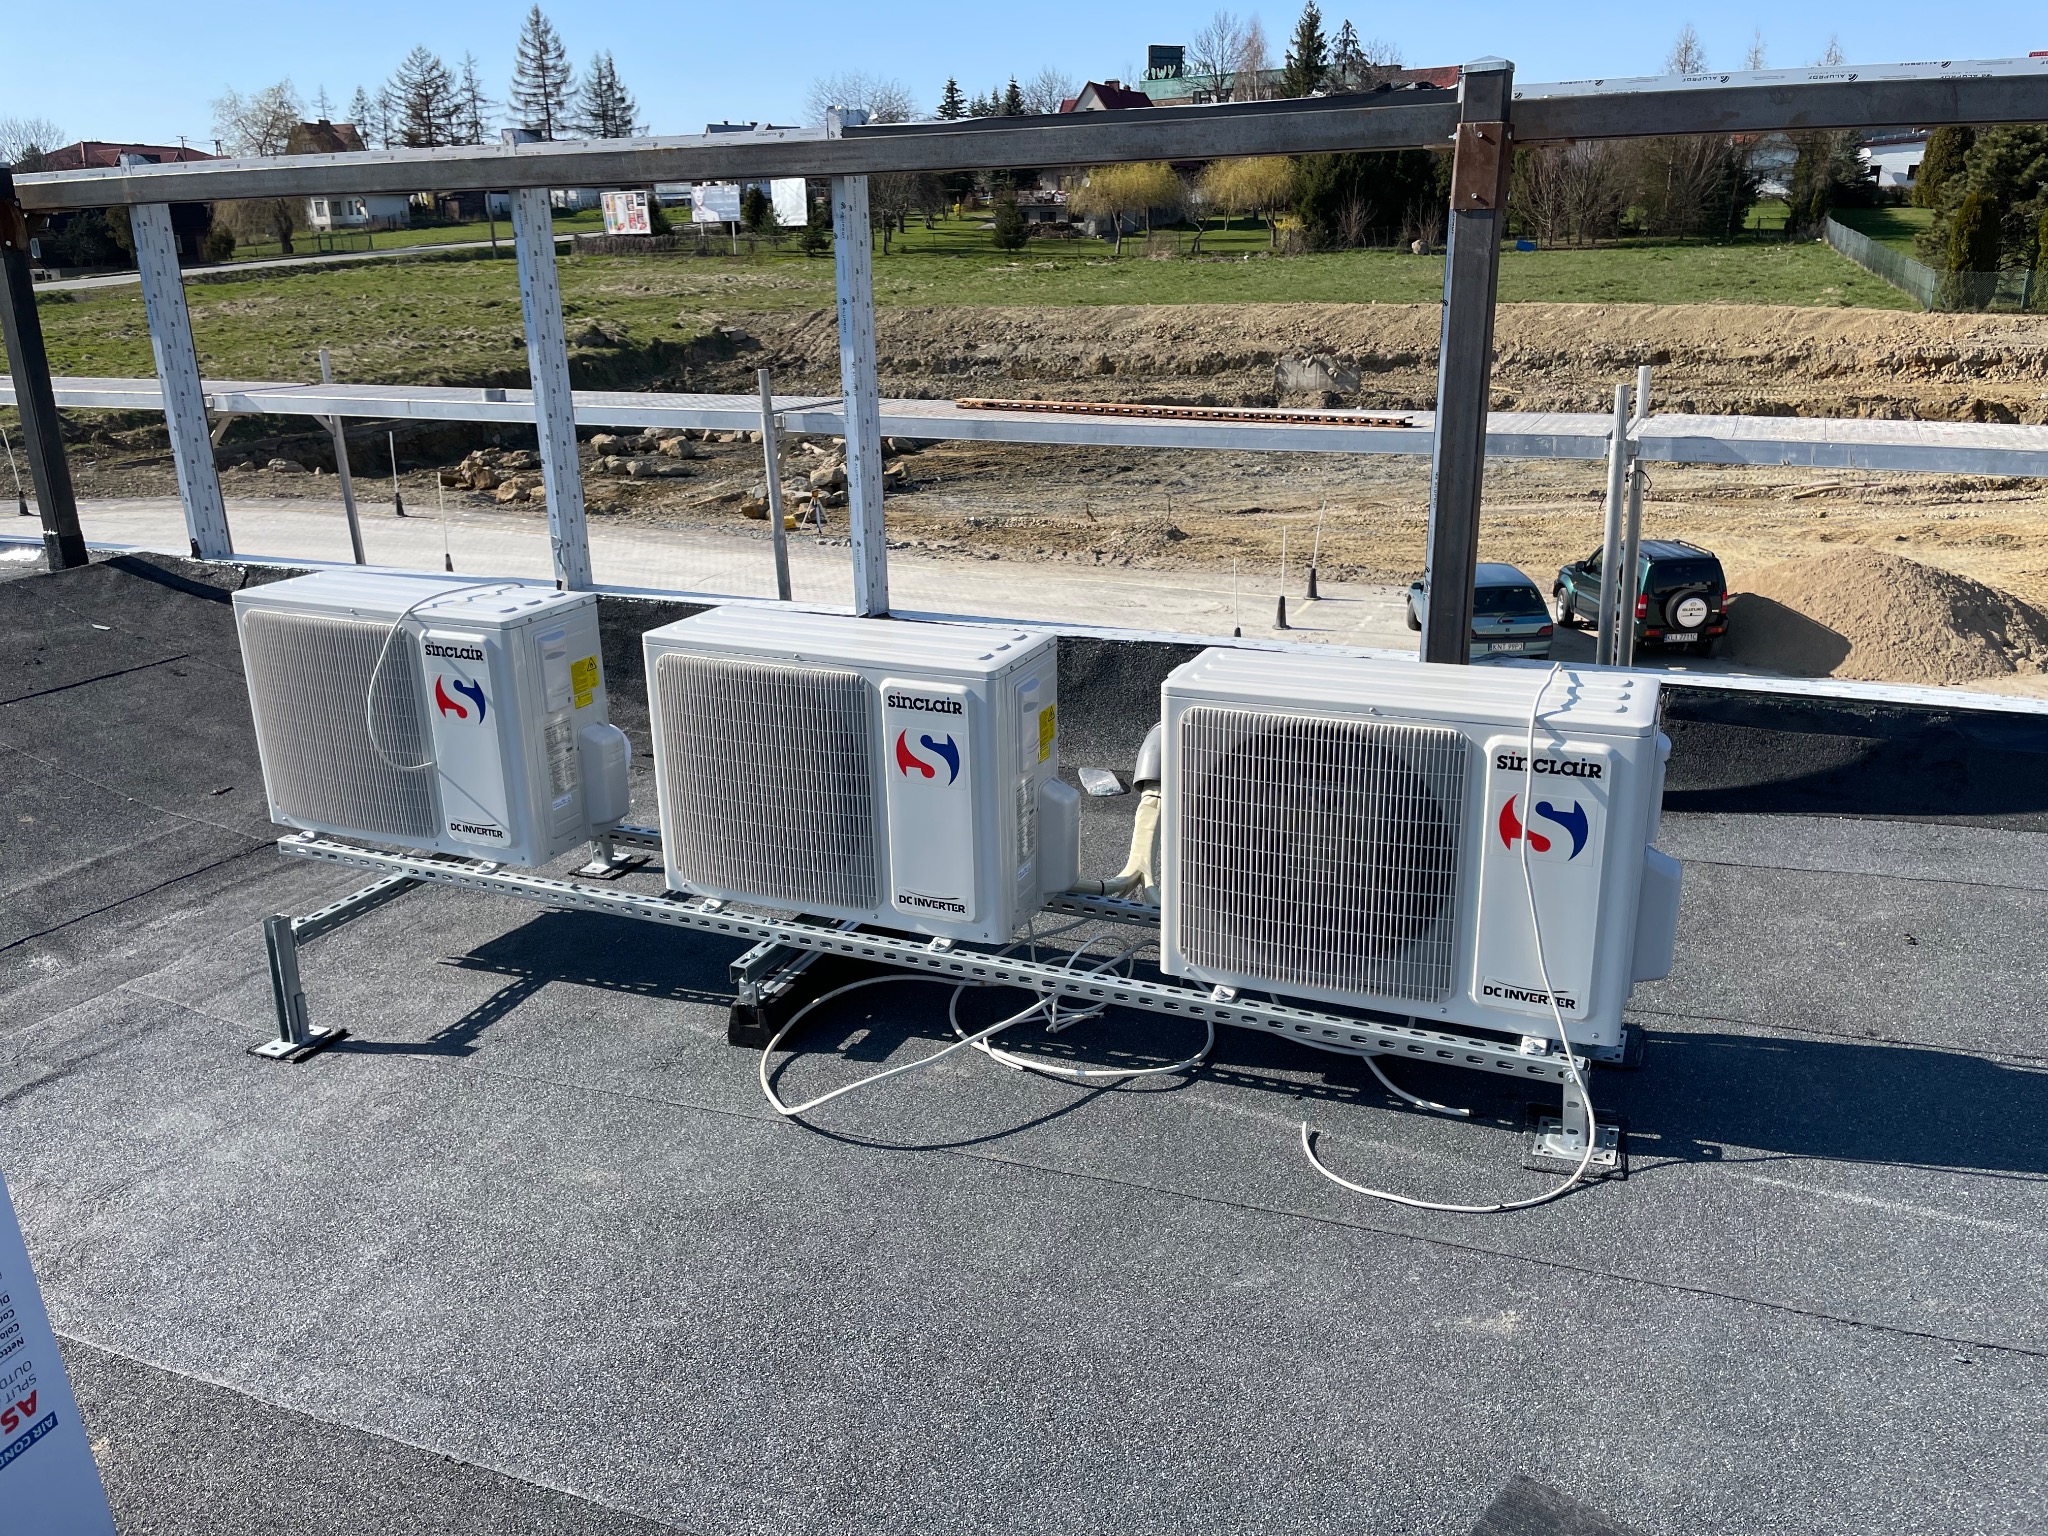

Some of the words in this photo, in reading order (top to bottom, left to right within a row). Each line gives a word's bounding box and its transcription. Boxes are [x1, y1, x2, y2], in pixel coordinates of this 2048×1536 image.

[450, 823, 461, 832] DC
[462, 825, 504, 838] INVERTER
[898, 894, 912, 905] DC
[913, 897, 966, 914] INVERTER
[1483, 985, 1502, 998] DC
[5, 1373, 37, 1404] SPLIT
[0, 1389, 37, 1435] AS
[32, 1415, 54, 1439] AIR
